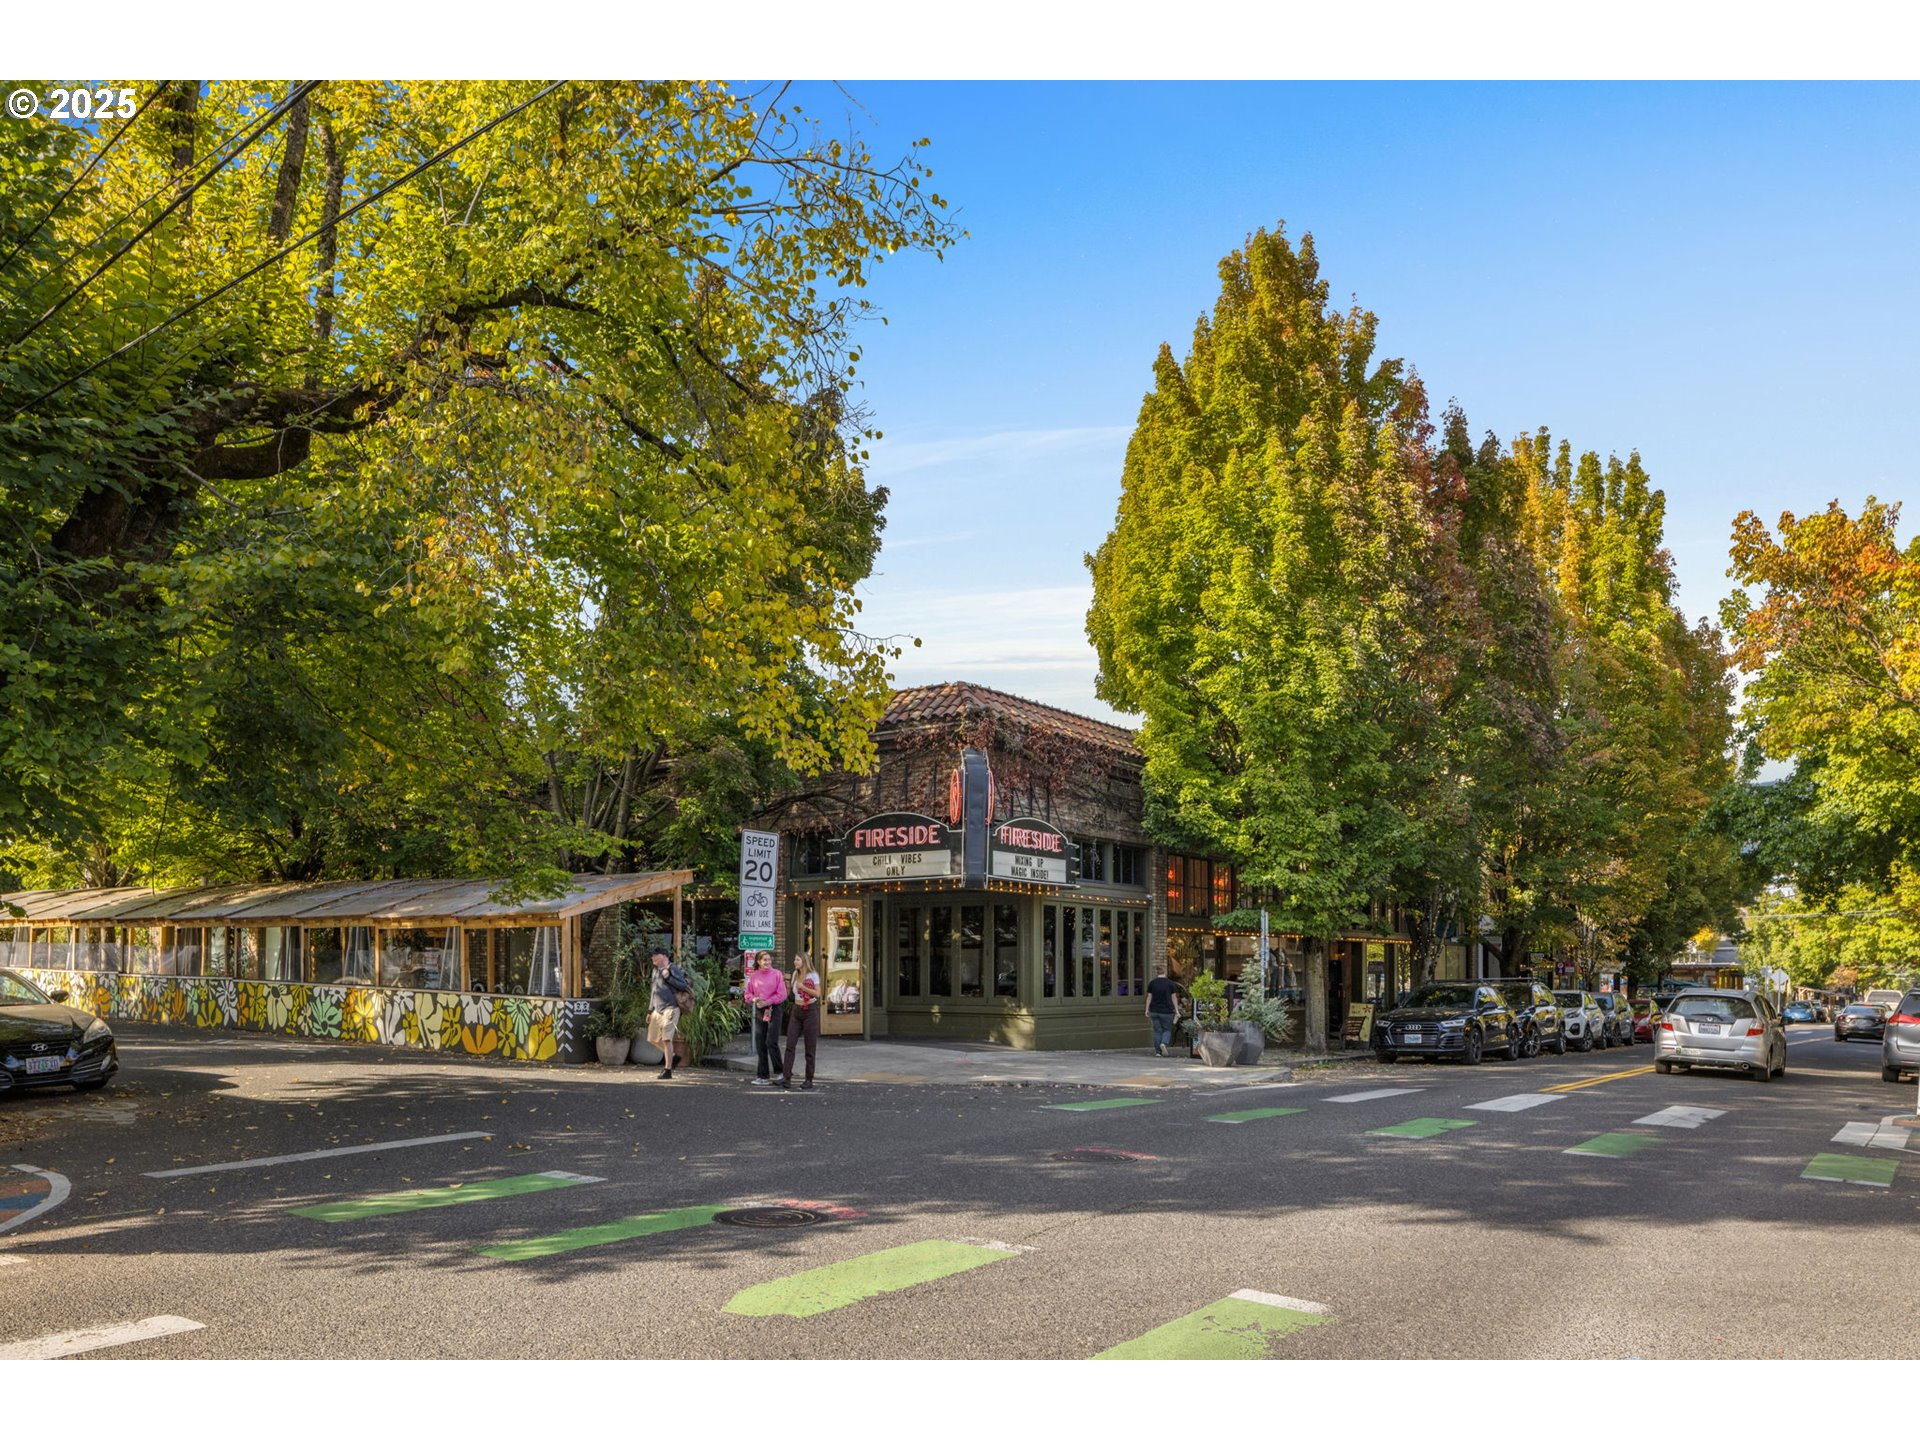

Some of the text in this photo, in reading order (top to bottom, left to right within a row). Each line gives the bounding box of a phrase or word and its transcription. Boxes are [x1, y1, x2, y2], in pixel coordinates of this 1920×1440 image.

[854, 824, 941, 848] FIRESIDE
[1000, 826, 1062, 852] FIRESIDE
[746, 836, 775, 848] SPEED
[748, 848, 772, 859] LIMIT
[900, 853, 922, 864] VIBES
[1036, 858, 1044, 868] UP
[744, 860, 773, 882] 20
[886, 866, 906, 877] ONLY
[1010, 866, 1027, 877] MAGIC
[745, 909, 769, 918] MAY USE
[742, 919, 771, 929] FULL LANE
